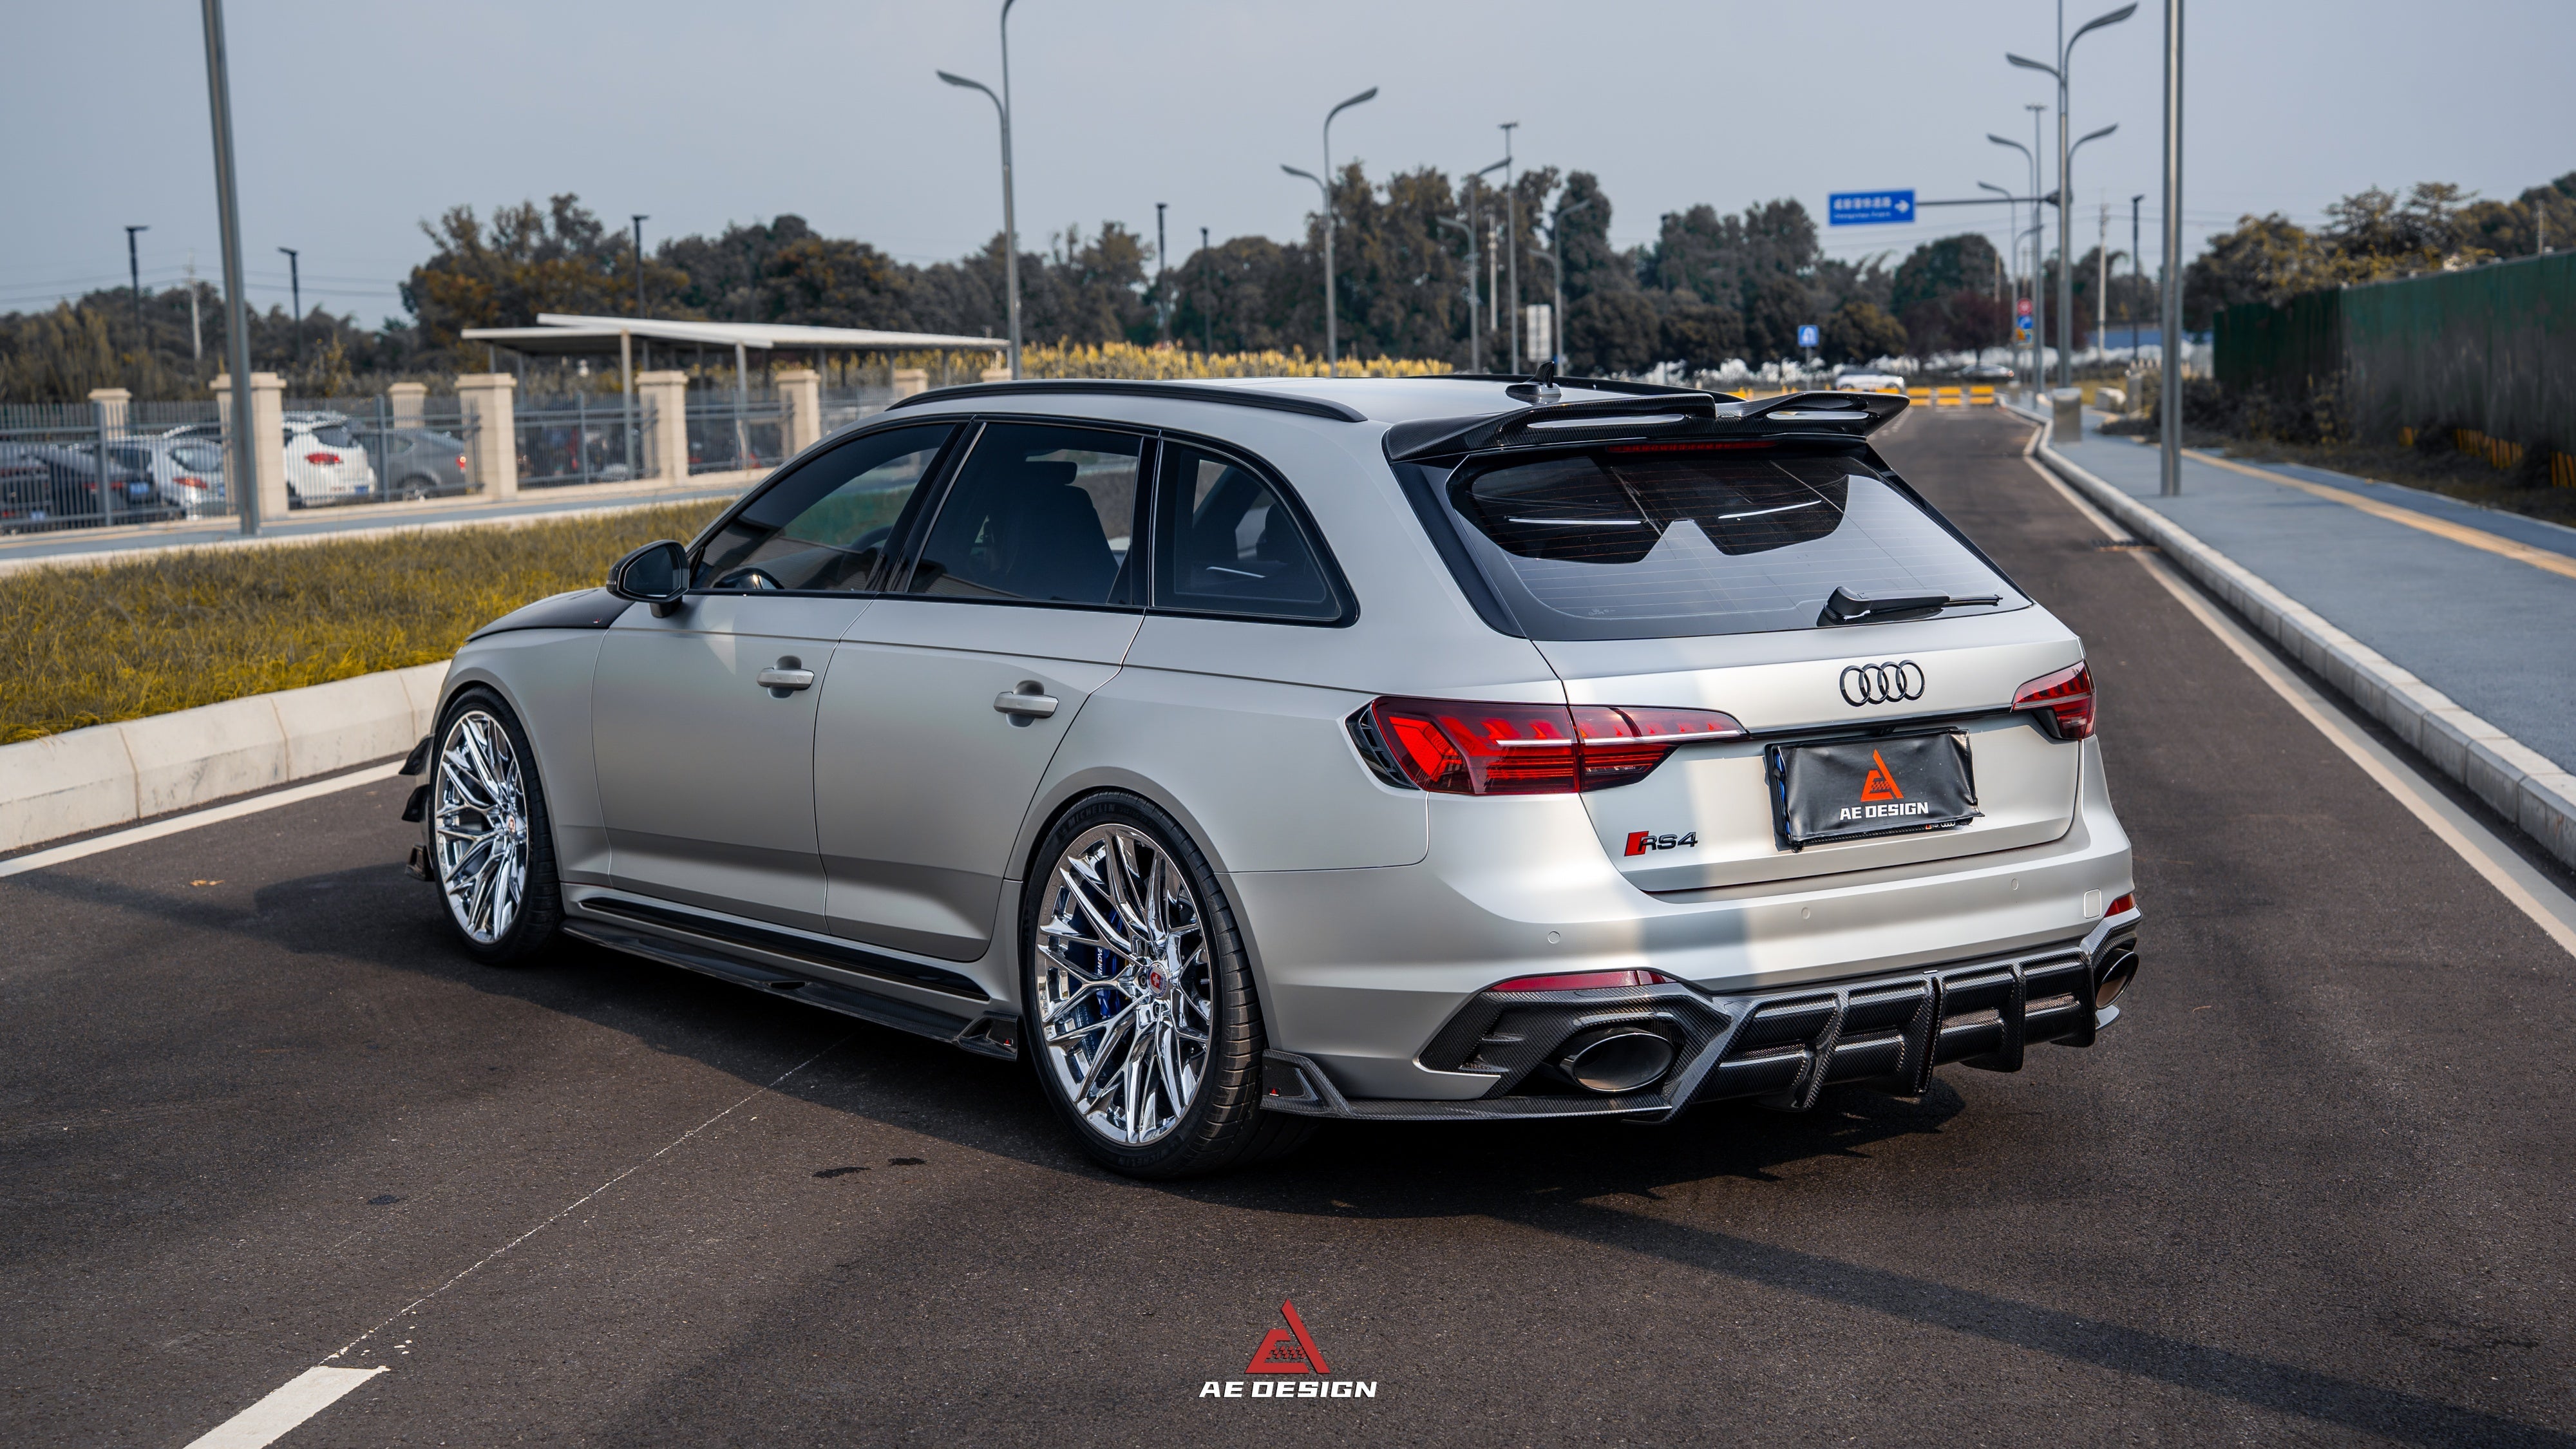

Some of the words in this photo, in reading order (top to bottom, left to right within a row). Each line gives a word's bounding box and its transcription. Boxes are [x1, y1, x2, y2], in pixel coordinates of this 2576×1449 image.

[1068, 804, 1115, 829] MICHELIN
[1839, 806, 1862, 820] AE
[1864, 802, 1929, 819] DESIGN
[1637, 831, 1698, 851] RS4
